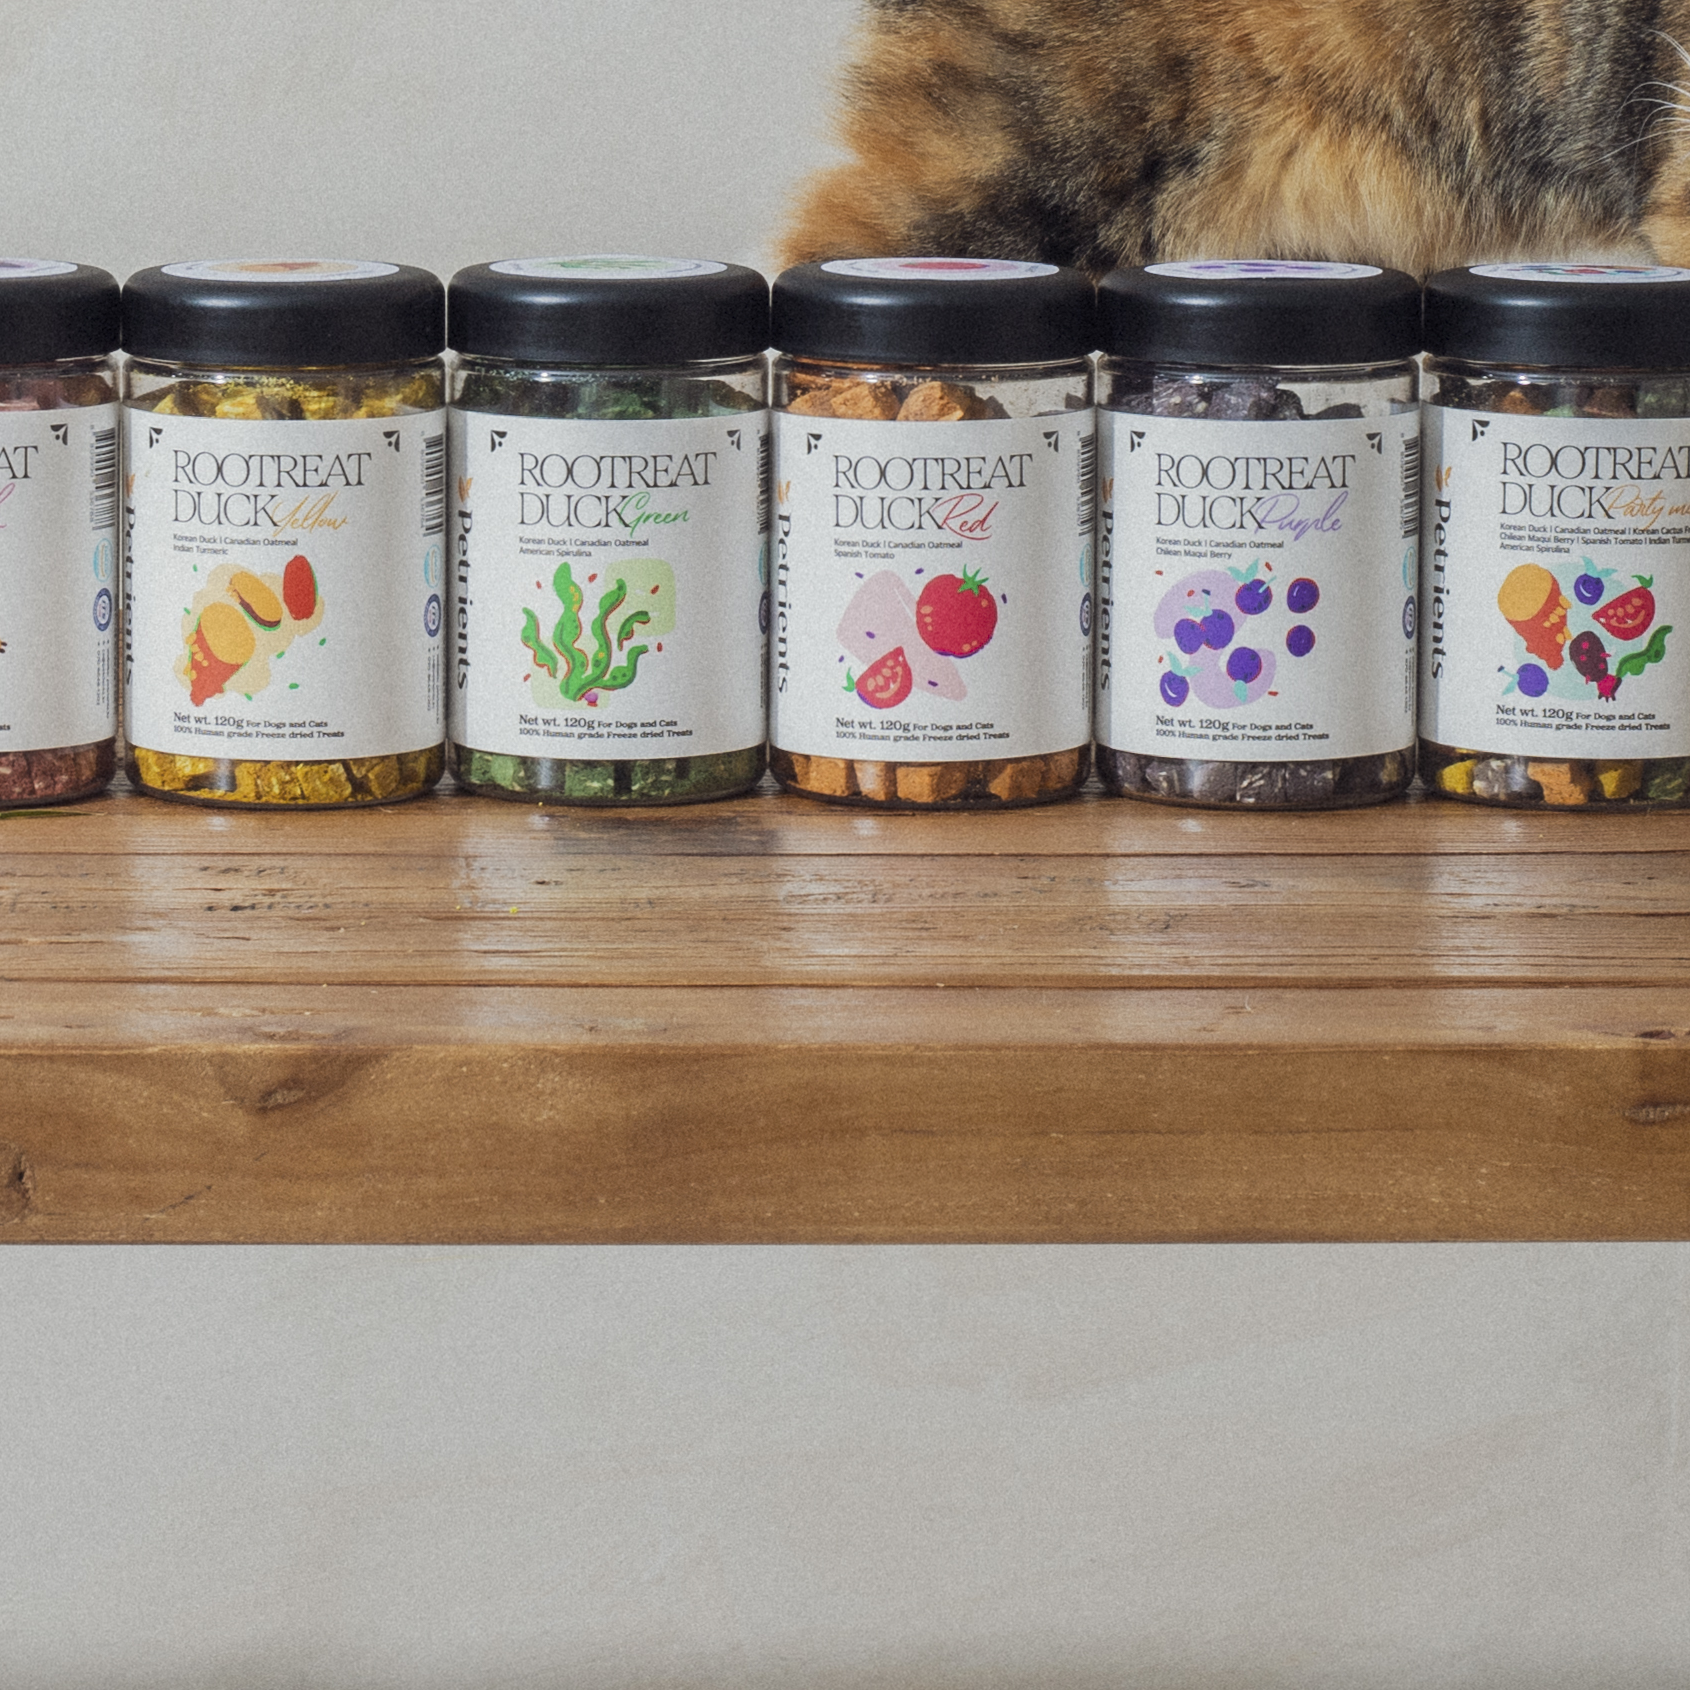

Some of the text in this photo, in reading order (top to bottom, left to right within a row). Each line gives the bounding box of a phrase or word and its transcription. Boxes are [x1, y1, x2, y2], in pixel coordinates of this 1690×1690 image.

[173, 450, 372, 487] ROOTREAT
[518, 452, 717, 489] ROOTREAT
[833, 454, 1032, 491] ROOTREAT
[1155, 453, 1356, 490] ROOTREAT
[1500, 482, 1615, 519] DUCK
[173, 489, 348, 537] DUCK Yellow
[518, 492, 689, 538] DUCK Green
[833, 493, 999, 541] DUCK Red
[1155, 491, 1348, 542] DUCK Purple
[1500, 523, 1526, 532] Korean
[1528, 524, 1547, 532] Duck
[1555, 526, 1591, 534] Canadian
[1594, 527, 1626, 535] Oatmeal
[1633, 527, 1659, 535] Korean
[1661, 526, 1683, 535] Cactus
[173, 534, 298, 546] Korean Duck Canadian Oatmeal
[519, 536, 545, 545] Korean
[547, 538, 567, 546] Duck
[834, 539, 859, 547] Korean
[862, 540, 880, 548] Duck
[928, 541, 963, 549] Oatmeal
[1156, 537, 1181, 546] Korean
[1184, 539, 1202, 547] Duck
[1210, 540, 1246, 548] Canadian
[1500, 532, 1526, 542] Chilean
[1528, 534, 1552, 544] Maqui
[1554, 536, 1574, 545] Berry
[1581, 537, 1611, 546] Spanish
[1649, 536, 1670, 544] Indian
[173, 544, 228, 554] Indian Turmeric
[519, 546, 591, 558] American Spirulina
[834, 549, 895, 559] Spanish Tomato
[1156, 547, 1232, 559] Chilean Maqui Berry
[1500, 543, 1570, 554] American Spirulina
[1431, 498, 1452, 680] Petrients
[457, 509, 473, 690] Petrients
[777, 513, 792, 693] Petrients
[1100, 509, 1114, 691] Petrients
[1496, 704, 1655, 721] Net wt. 120g For Dogs and Cats
[174, 712, 190, 723] Net
[194, 716, 210, 725] wt.
[214, 716, 244, 729] 120g
[264, 721, 286, 729] Dogs
[519, 714, 538, 725] Net
[542, 718, 559, 726] wt.
[564, 718, 595, 730] 120g
[615, 721, 637, 729] Dogs
[836, 718, 854, 728] Net
[858, 721, 876, 730] wt.
[880, 720, 910, 733] 120g
[931, 723, 952, 732] Dogs
[1156, 715, 1174, 726] Net
[1178, 719, 1195, 728] wt.
[1199, 719, 1230, 732] 120g
[1250, 723, 1272, 732] Dogs
[1496, 718, 1517, 726] 100%
[1520, 720, 1552, 729] Human
[1555, 723, 1582, 731] grade
[174, 725, 192, 734] 100%
[194, 727, 224, 736] Human
[227, 730, 253, 738] grade
[519, 728, 540, 736] 100%
[542, 730, 574, 738] Human
[640, 730, 664, 738] dried
[836, 731, 856, 739] 100%
[859, 733, 890, 741] Human
[893, 734, 920, 742] grade
[956, 733, 980, 741] dried
[1156, 729, 1176, 737] 100%
[1178, 731, 1209, 740] Human
[1212, 733, 1238, 741] grade
